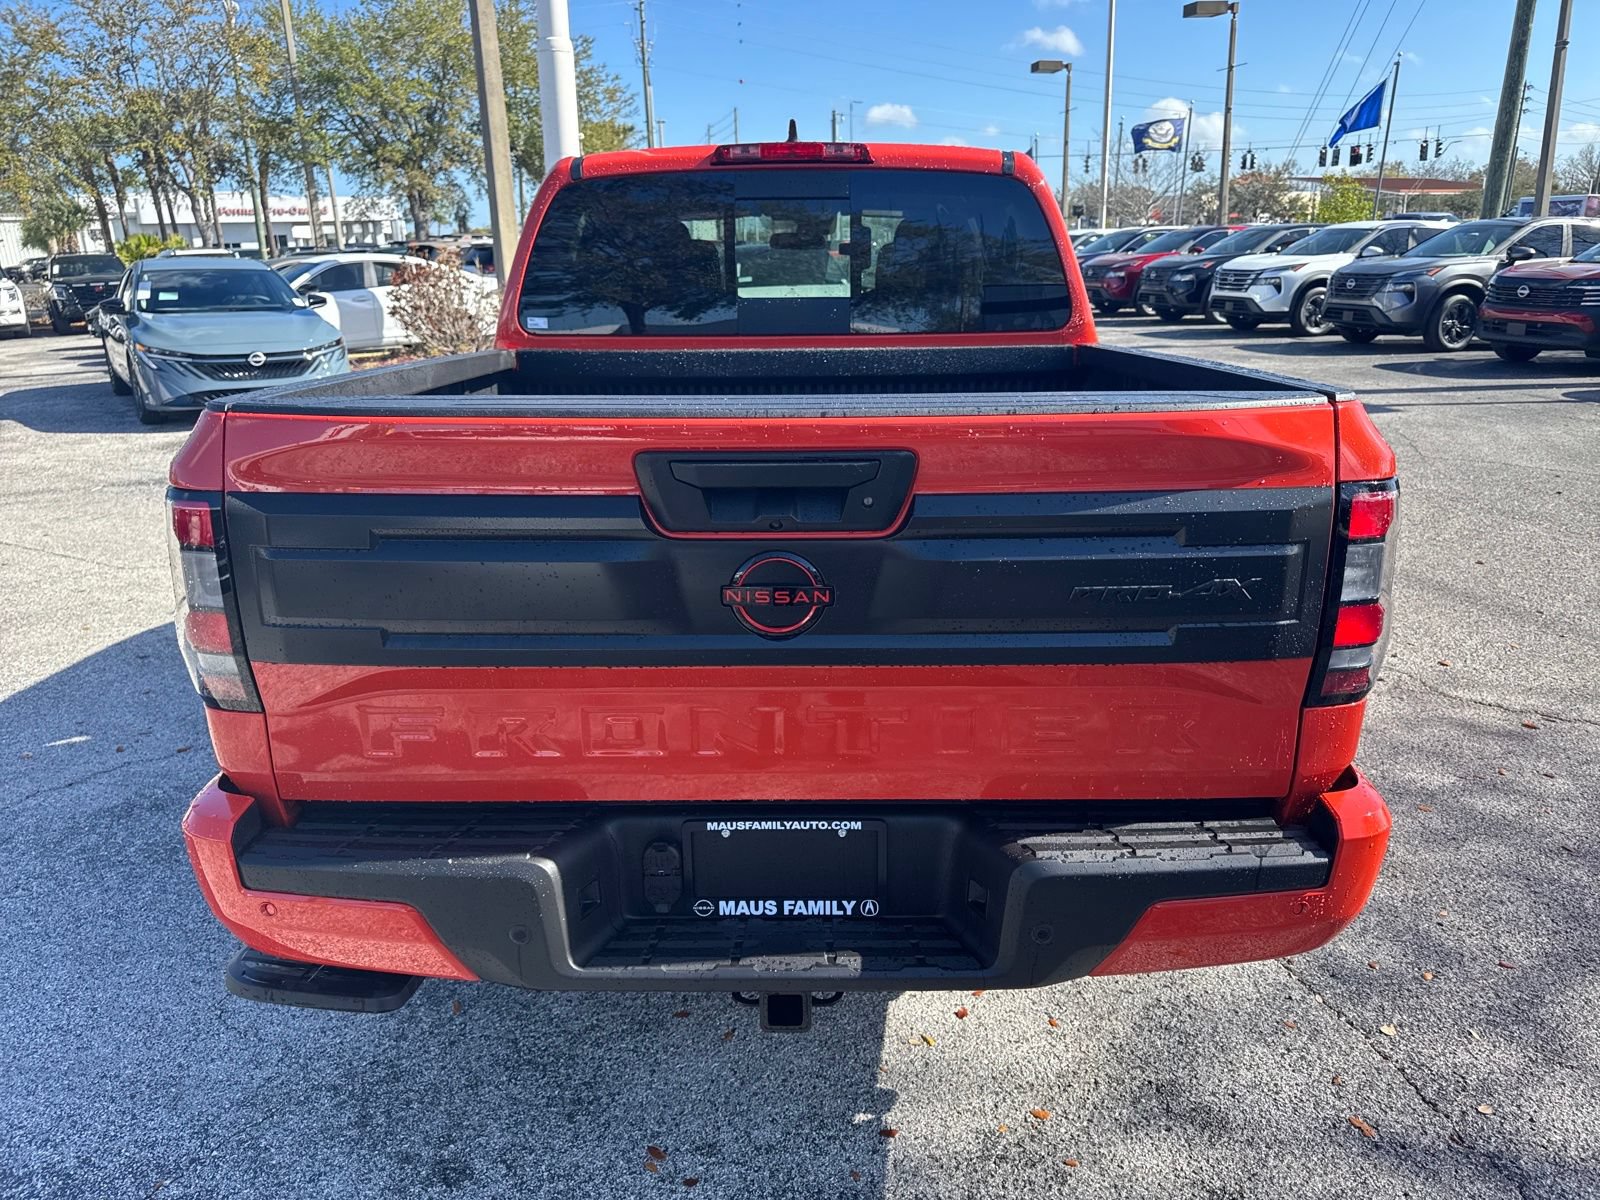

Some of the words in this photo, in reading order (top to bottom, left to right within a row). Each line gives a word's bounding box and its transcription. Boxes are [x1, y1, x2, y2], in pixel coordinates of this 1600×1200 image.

[725, 589, 830, 603] NISSAN
[356, 704, 1201, 759] FRONTIER
[706, 820, 863, 832] MAUSFAMILYAUTO.COM
[718, 899, 778, 916] MAUS
[782, 899, 857, 916] FAMILY
